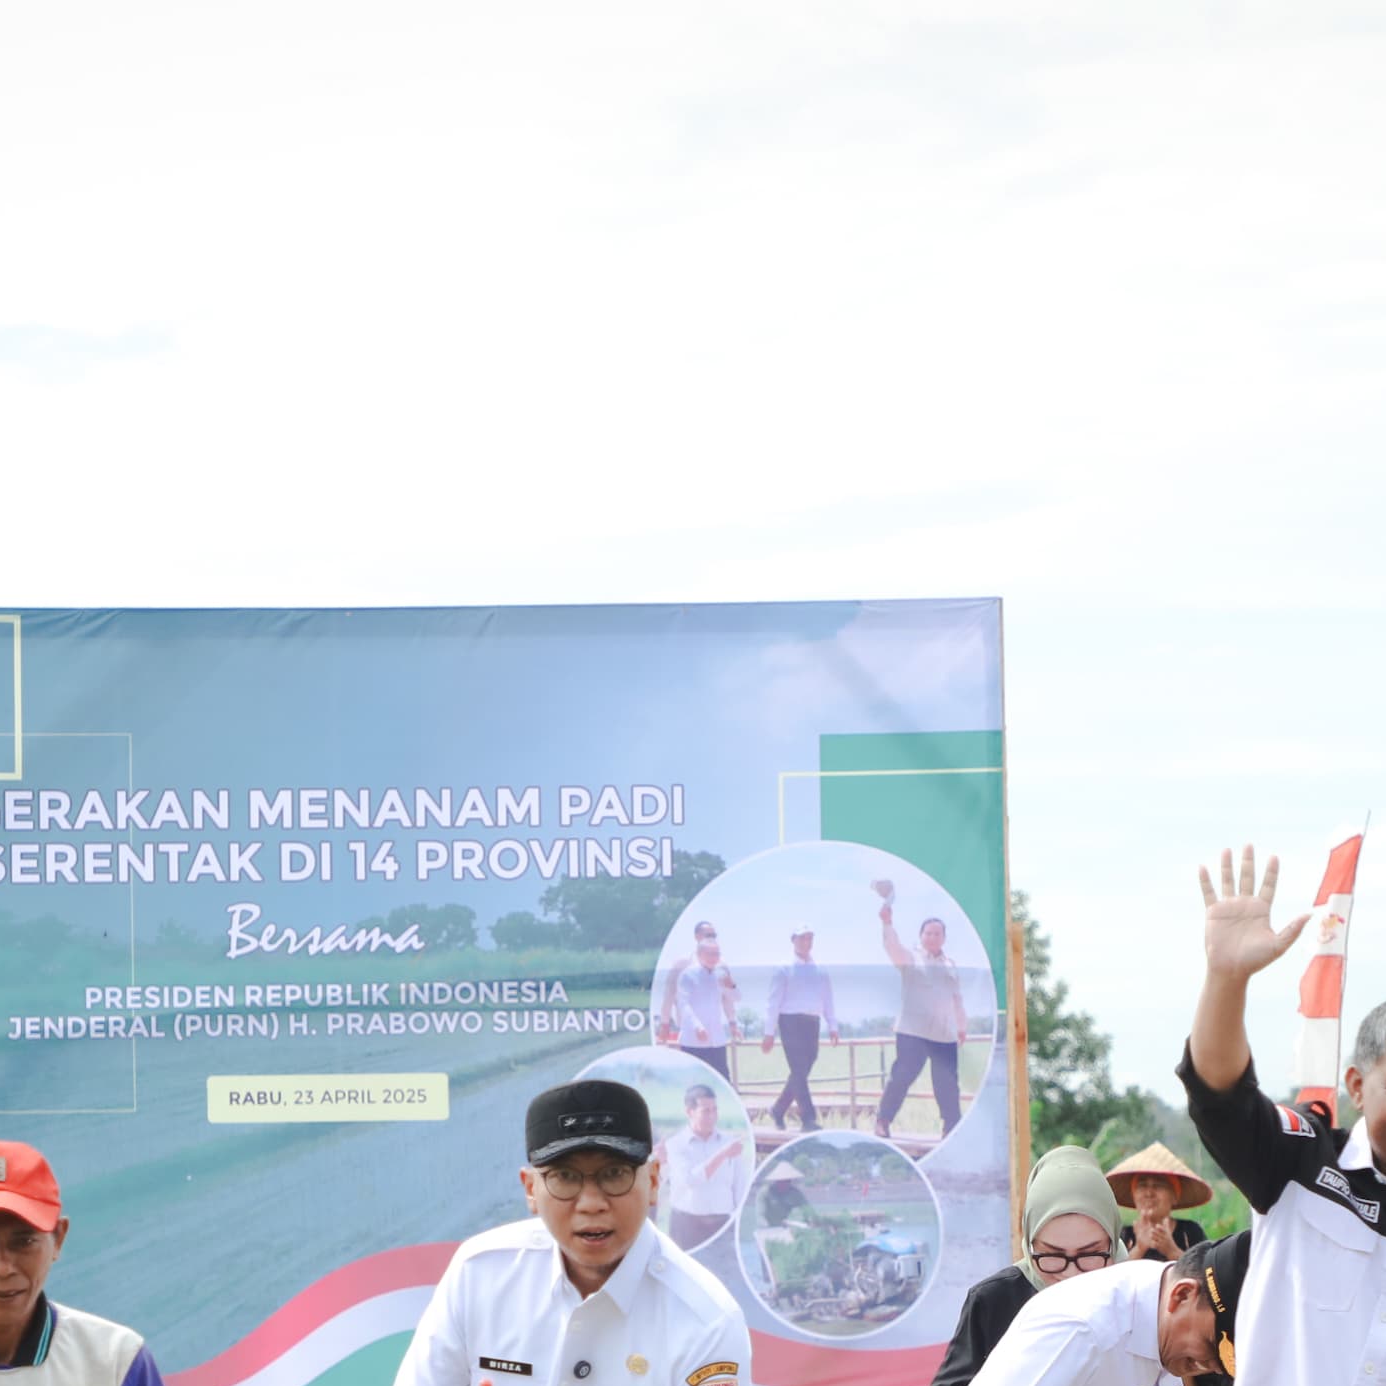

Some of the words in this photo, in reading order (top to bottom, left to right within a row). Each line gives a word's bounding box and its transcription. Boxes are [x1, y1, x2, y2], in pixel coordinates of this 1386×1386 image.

[248, 787, 541, 830] MENANAM
[559, 785, 685, 826] PADI
[279, 841, 332, 882] DI
[348, 840, 400, 881] 14
[416, 836, 674, 881] PROVINSI
[226, 902, 425, 959] Bersama
[85, 985, 235, 1009] PRESIDEN
[245, 983, 390, 1007] REPUBLIK
[400, 981, 569, 1005] INDONESIA
[8, 1016, 165, 1040] JENDERAL
[174, 1013, 279, 1041] (PURN)
[290, 1014, 317, 1036] H.
[327, 1010, 482, 1035] PRABOWO
[492, 1009, 646, 1033] SUBIANTO
[229, 1091, 288, 1107] RABU,
[293, 1090, 314, 1105] 23
[320, 1089, 376, 1105] APRIL
[382, 1088, 428, 1104] 2025
[489, 1361, 522, 1372] MIRZA
